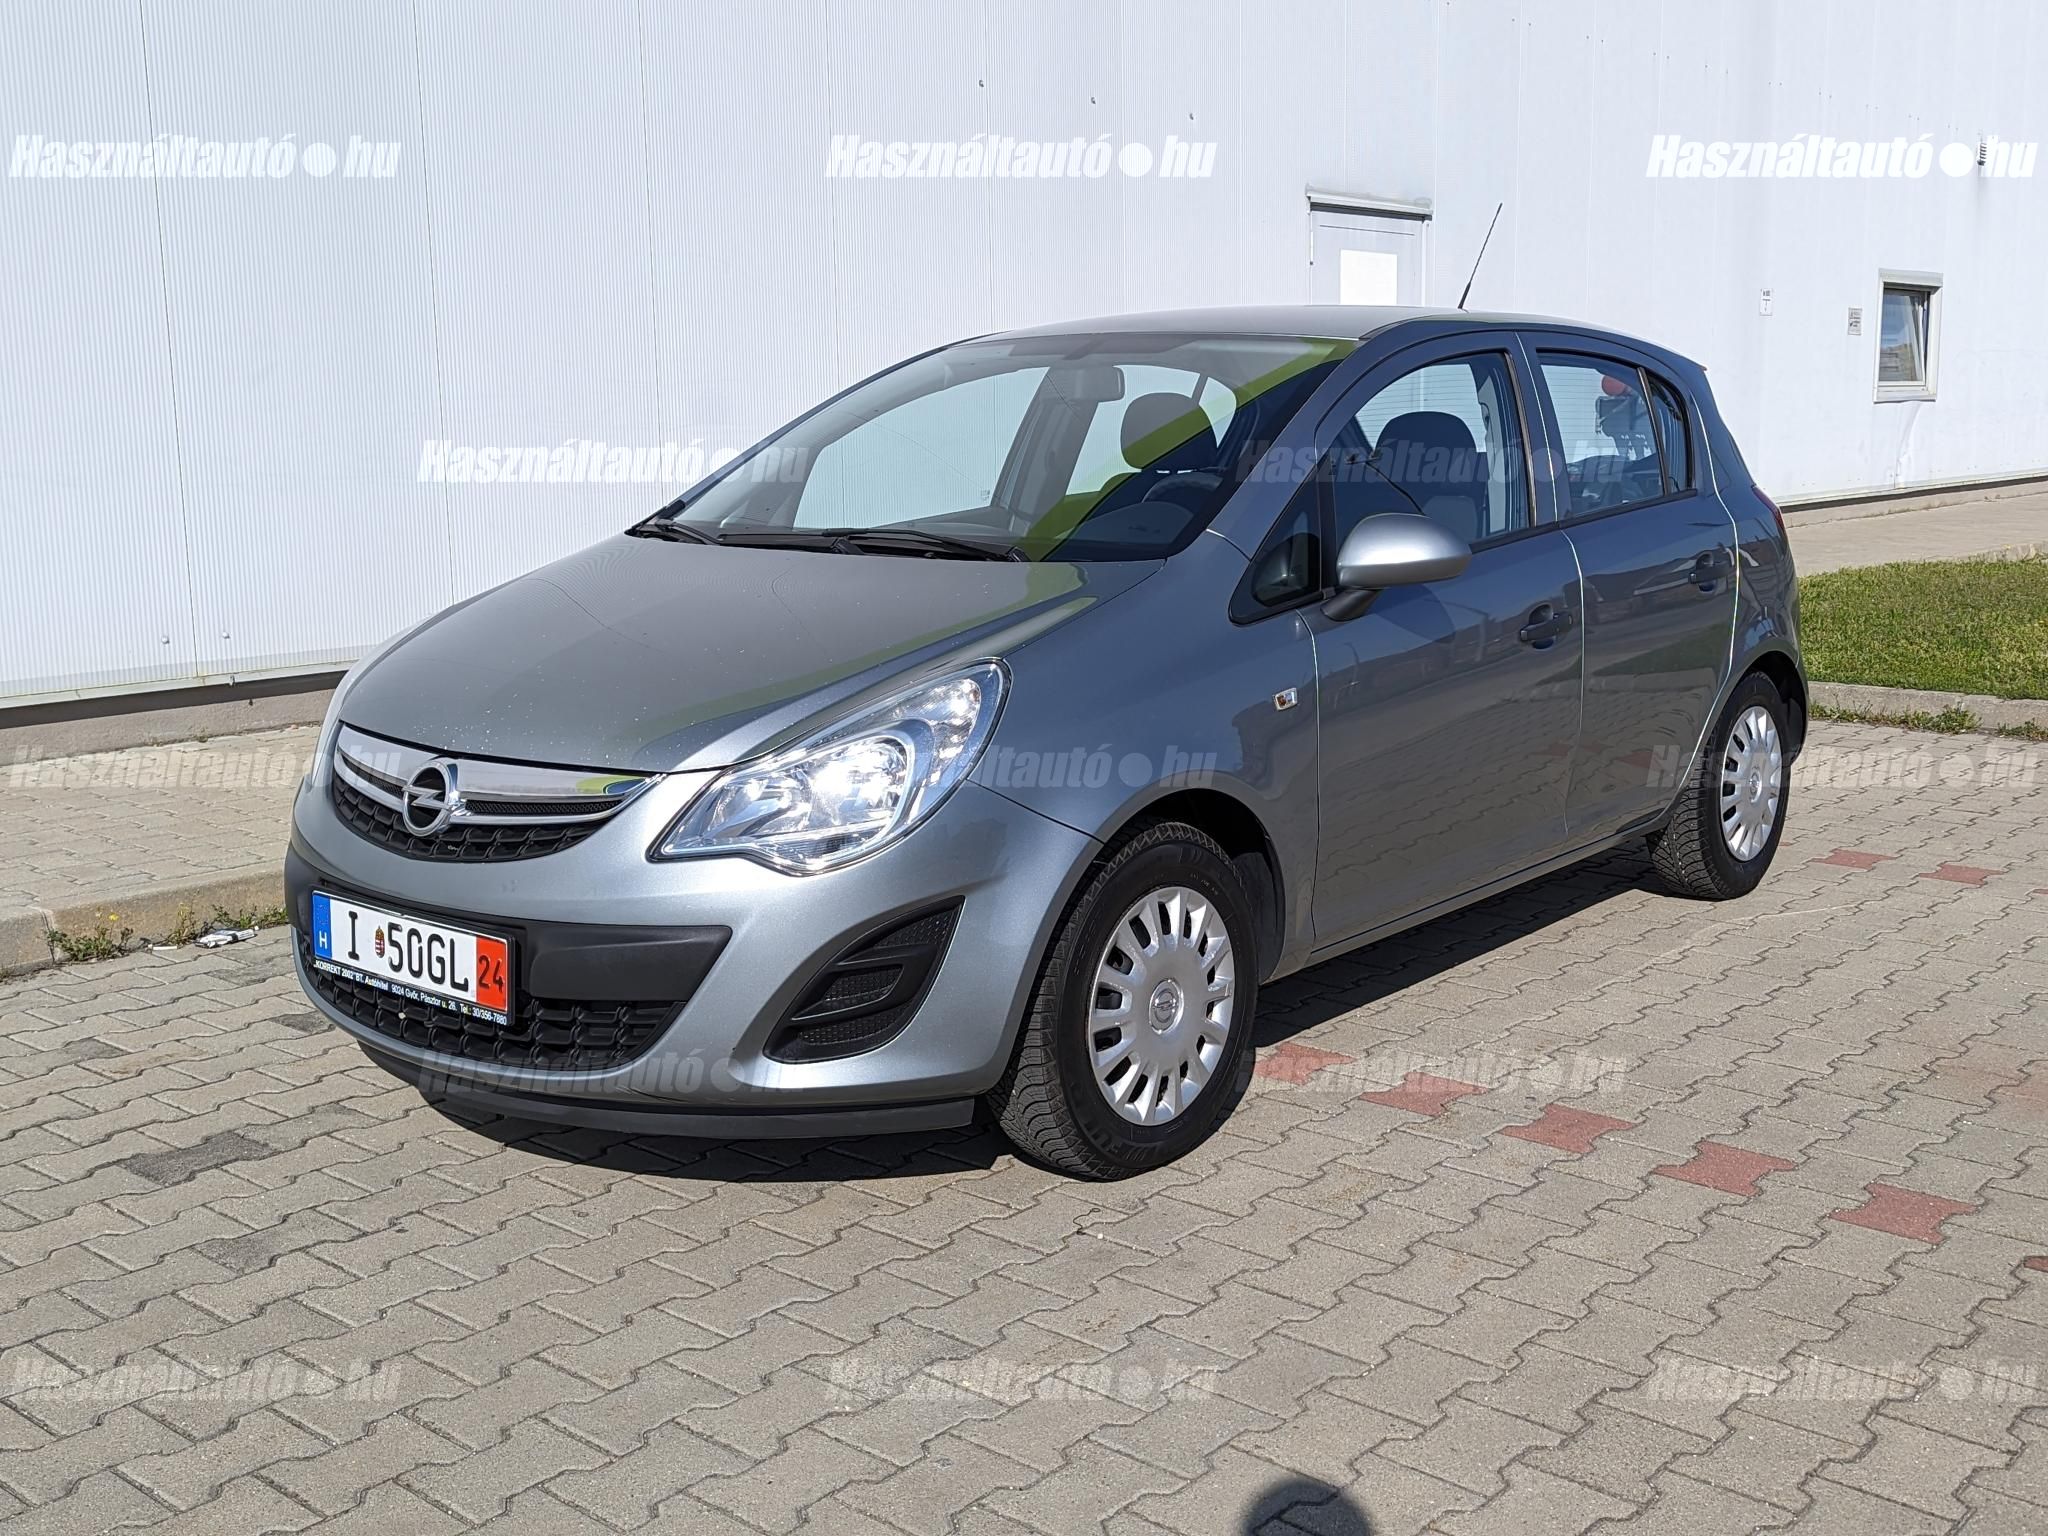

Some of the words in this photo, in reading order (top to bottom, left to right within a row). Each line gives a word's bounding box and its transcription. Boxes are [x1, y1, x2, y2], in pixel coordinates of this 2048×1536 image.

[318, 930, 328, 950] H
[348, 910, 360, 962] I
[478, 954, 504, 993] 24
